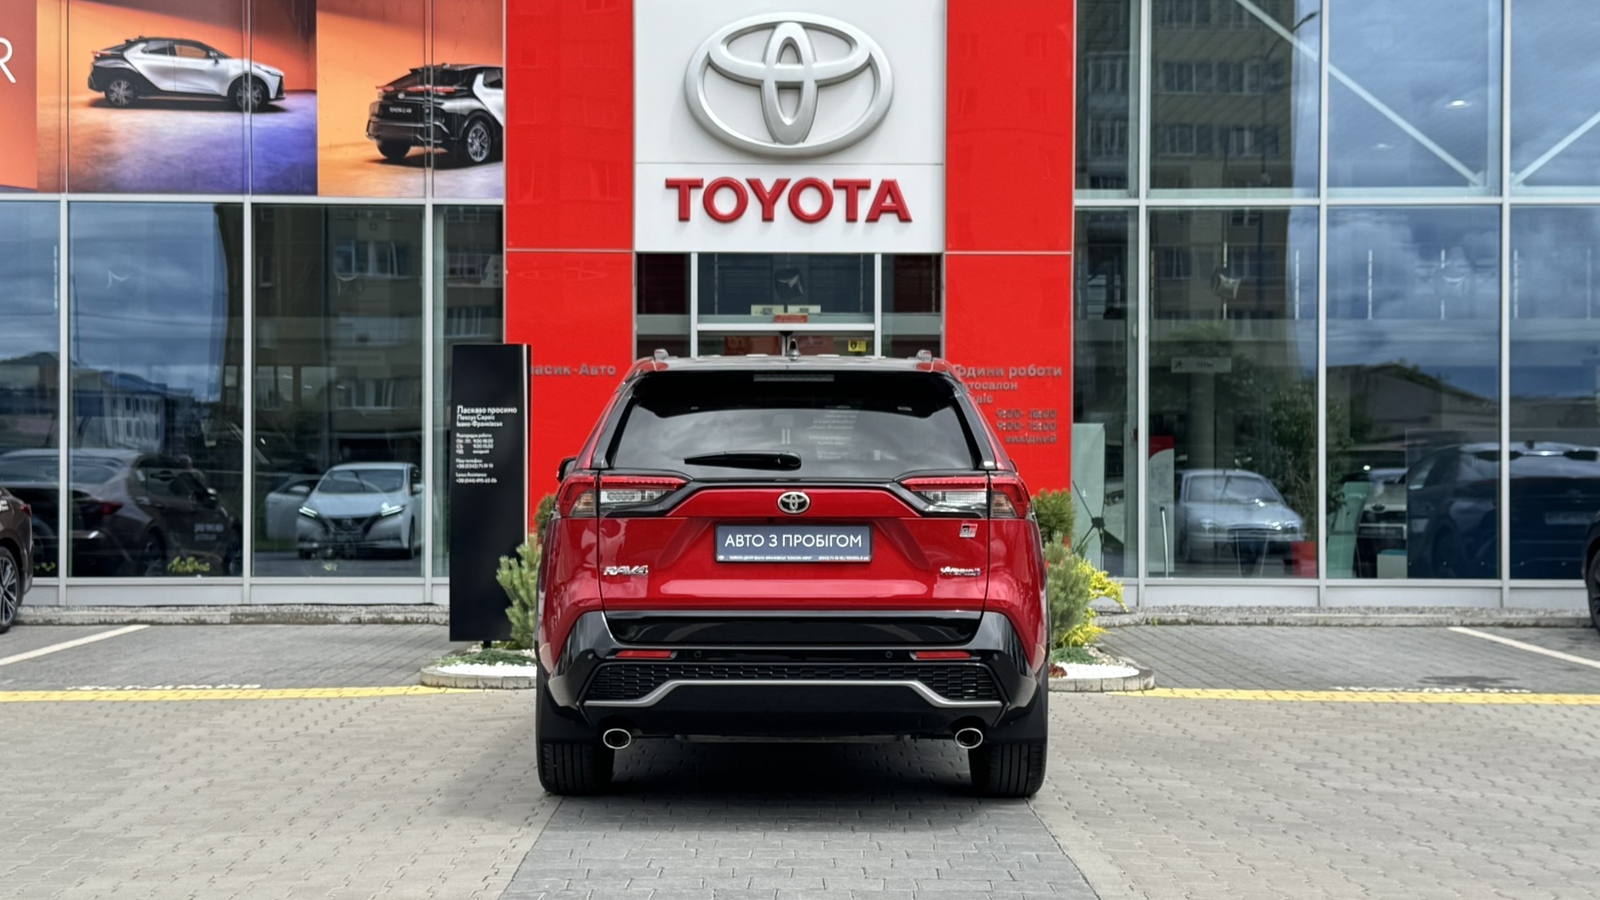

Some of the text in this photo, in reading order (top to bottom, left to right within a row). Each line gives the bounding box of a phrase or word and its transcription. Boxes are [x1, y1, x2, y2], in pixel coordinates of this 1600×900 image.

[665, 177, 913, 223] TOYOTA
[531, 364, 616, 375] асик-Авто
[1009, 364, 1062, 380] роботи
[967, 381, 1018, 390] тосалон
[487, 407, 518, 415] просимо
[725, 534, 765, 547] АВТО
[782, 534, 862, 547] ПРОБІГОМ
[603, 565, 649, 576] RAV4
